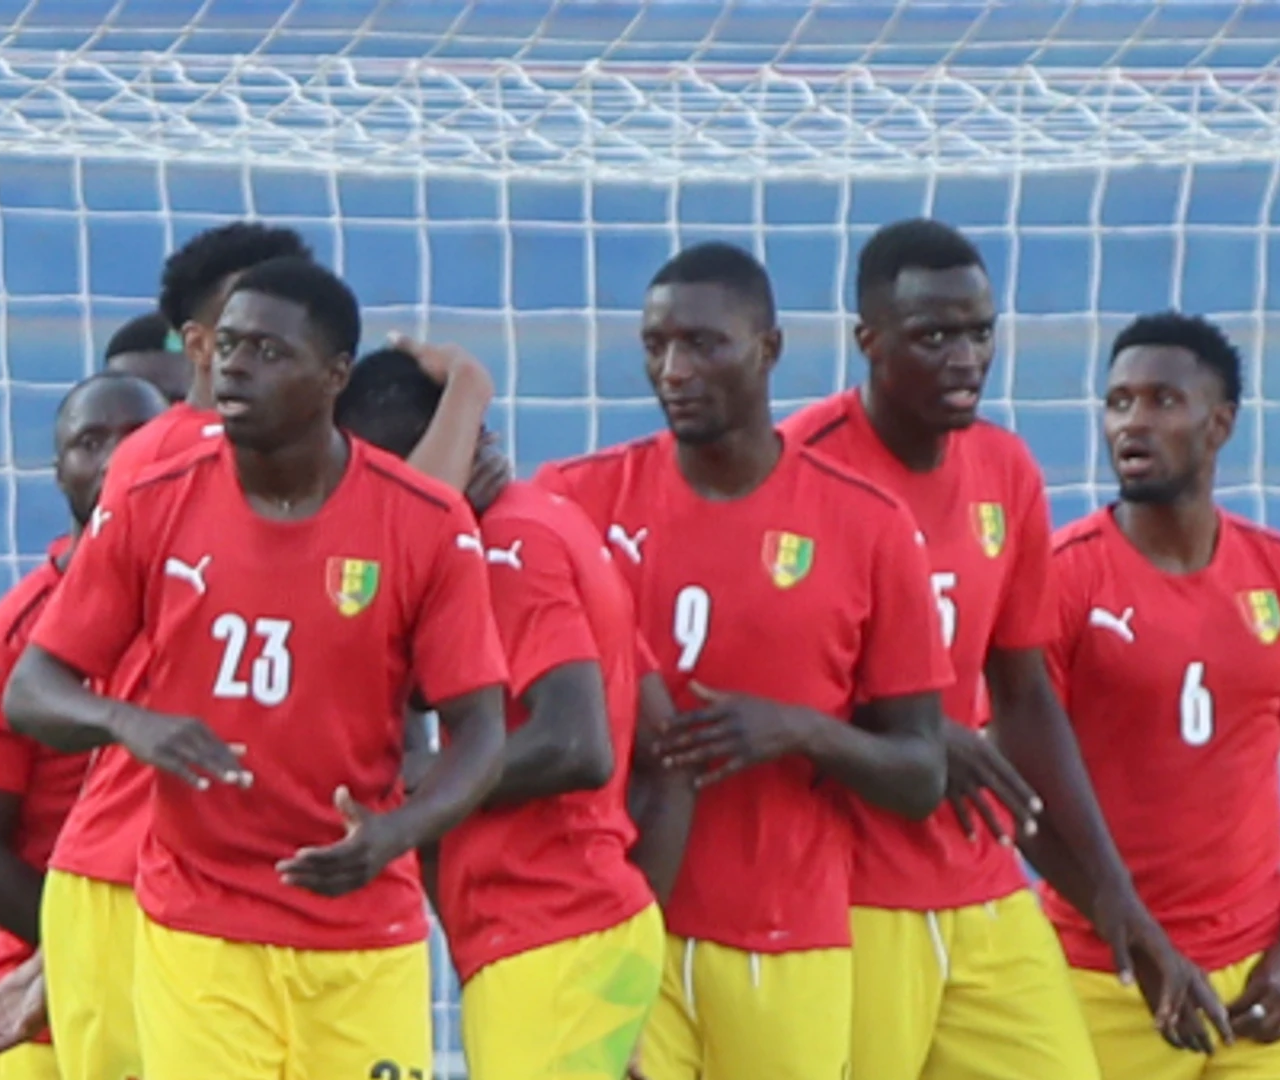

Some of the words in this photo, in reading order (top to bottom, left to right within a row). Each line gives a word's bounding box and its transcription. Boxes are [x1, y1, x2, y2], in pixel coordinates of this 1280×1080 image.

[212, 612, 293, 706] 23
[674, 585, 711, 671] 9
[1180, 661, 1214, 745] 6
